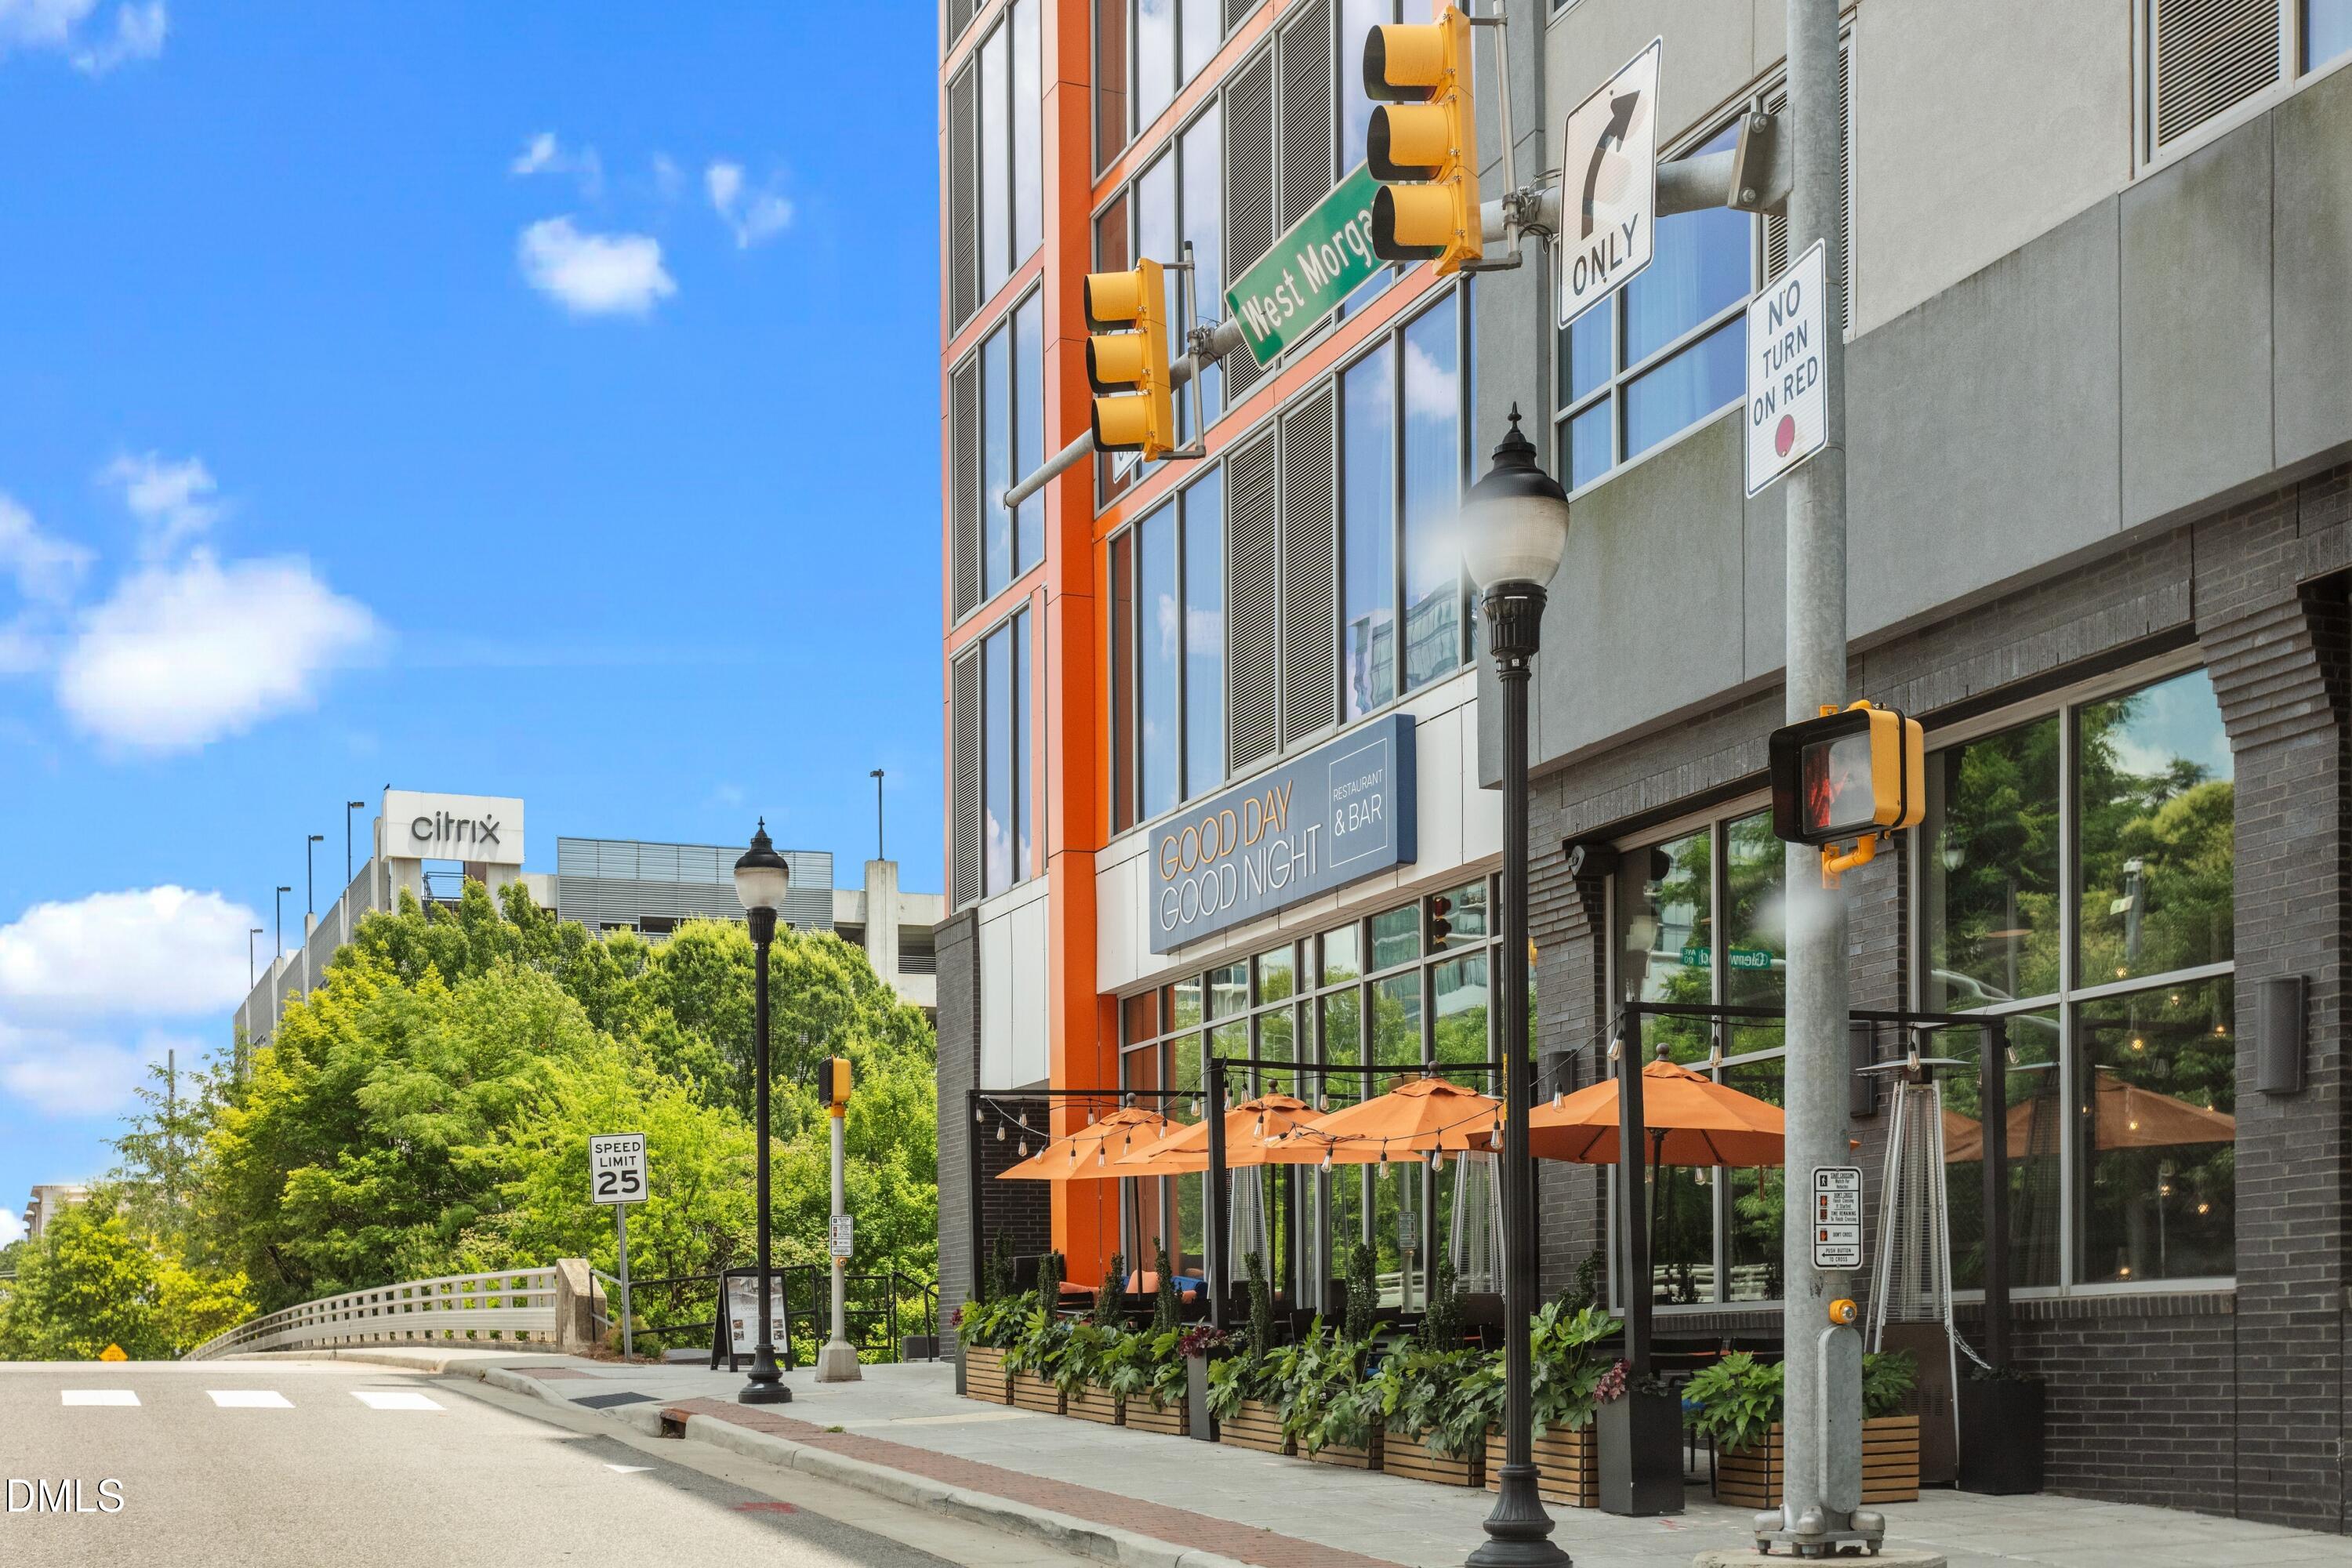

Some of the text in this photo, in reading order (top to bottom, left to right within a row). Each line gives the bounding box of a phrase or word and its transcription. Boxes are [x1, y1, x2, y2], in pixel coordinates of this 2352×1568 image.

[1241, 201, 1374, 342] West Morga
[1573, 212, 1639, 296] ONLY
[1769, 279, 1801, 336] NO
[1763, 319, 1808, 379] TURN
[1754, 356, 1818, 426] ON RED
[1333, 769, 1383, 802] RESTAURANT
[1160, 779, 1293, 880] GOOD DAY
[1334, 793, 1382, 837] & BAR
[1160, 823, 1323, 931] GOOD NIGHT
[595, 1142, 641, 1153] SPEED
[600, 1156, 637, 1167] LIMIT
[597, 1170, 641, 1195] 25
